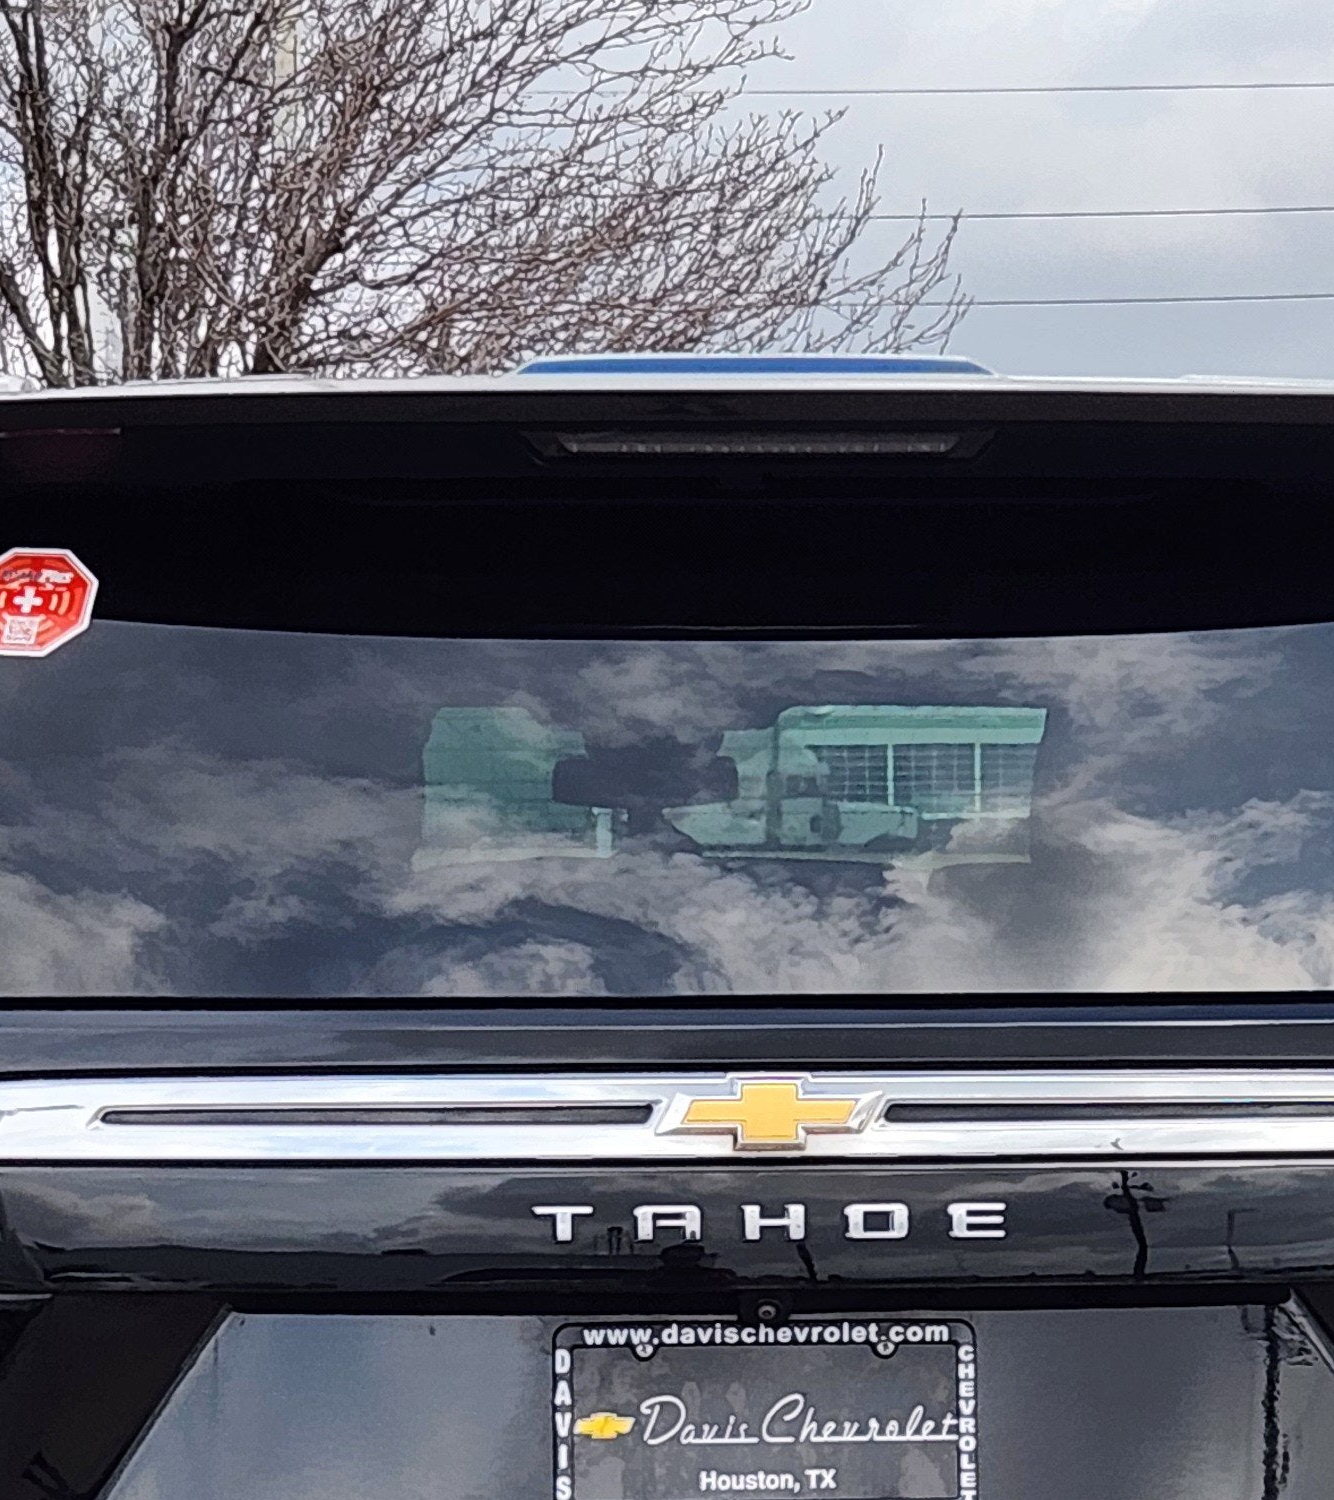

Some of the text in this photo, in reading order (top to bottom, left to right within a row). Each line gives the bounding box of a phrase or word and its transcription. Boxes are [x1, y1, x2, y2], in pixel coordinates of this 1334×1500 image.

[531, 1202, 1007, 1242] TAHOE
[583, 1322, 950, 1346] www.davischevrolet.com
[639, 1392, 959, 1445] Davis Chevrolet
[699, 1469, 837, 1492] Houston, TX
